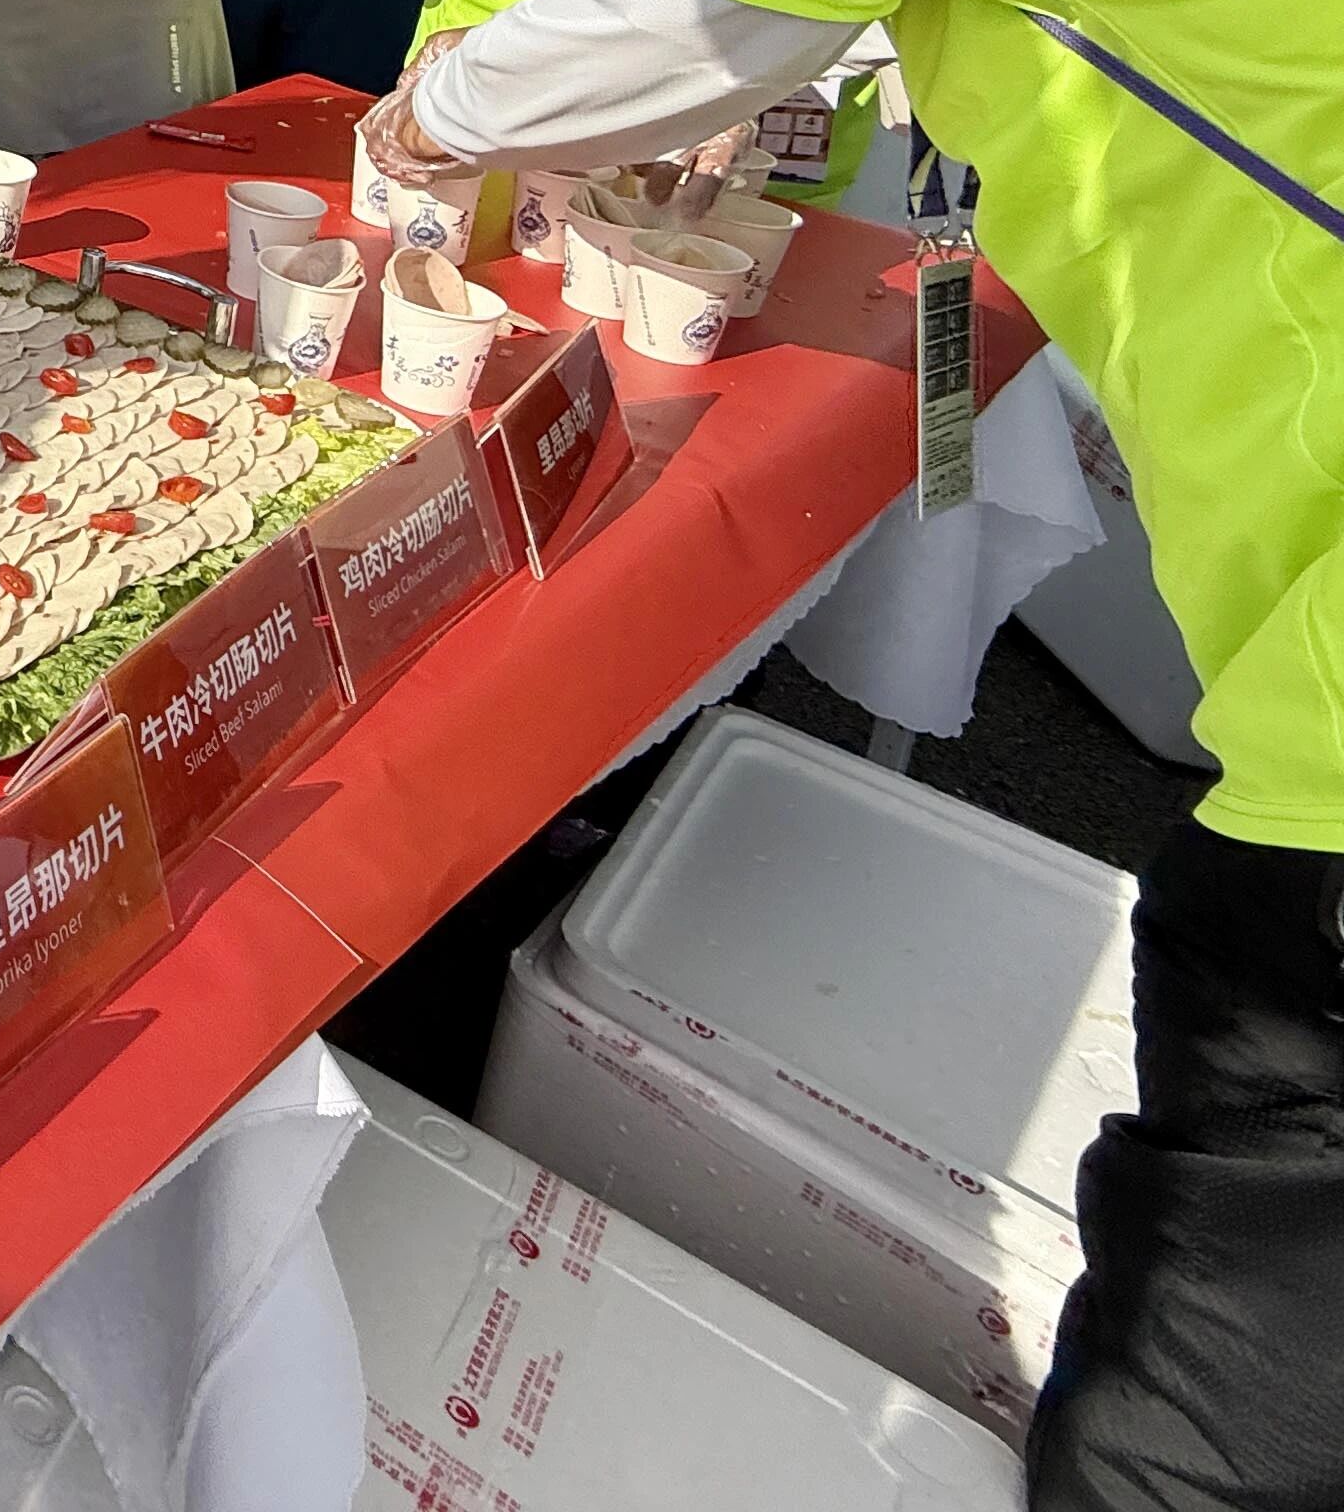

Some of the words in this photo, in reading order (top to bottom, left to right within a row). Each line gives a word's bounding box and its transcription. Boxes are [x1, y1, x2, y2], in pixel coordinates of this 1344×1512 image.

[337, 473, 474, 599] 鸡肉冷切肠切片
[138, 601, 299, 763] 牛肉冷切肠切片
[183, 726, 221, 777] Sliced
[218, 708, 246, 745] Beef
[244, 678, 286, 722] Salami
